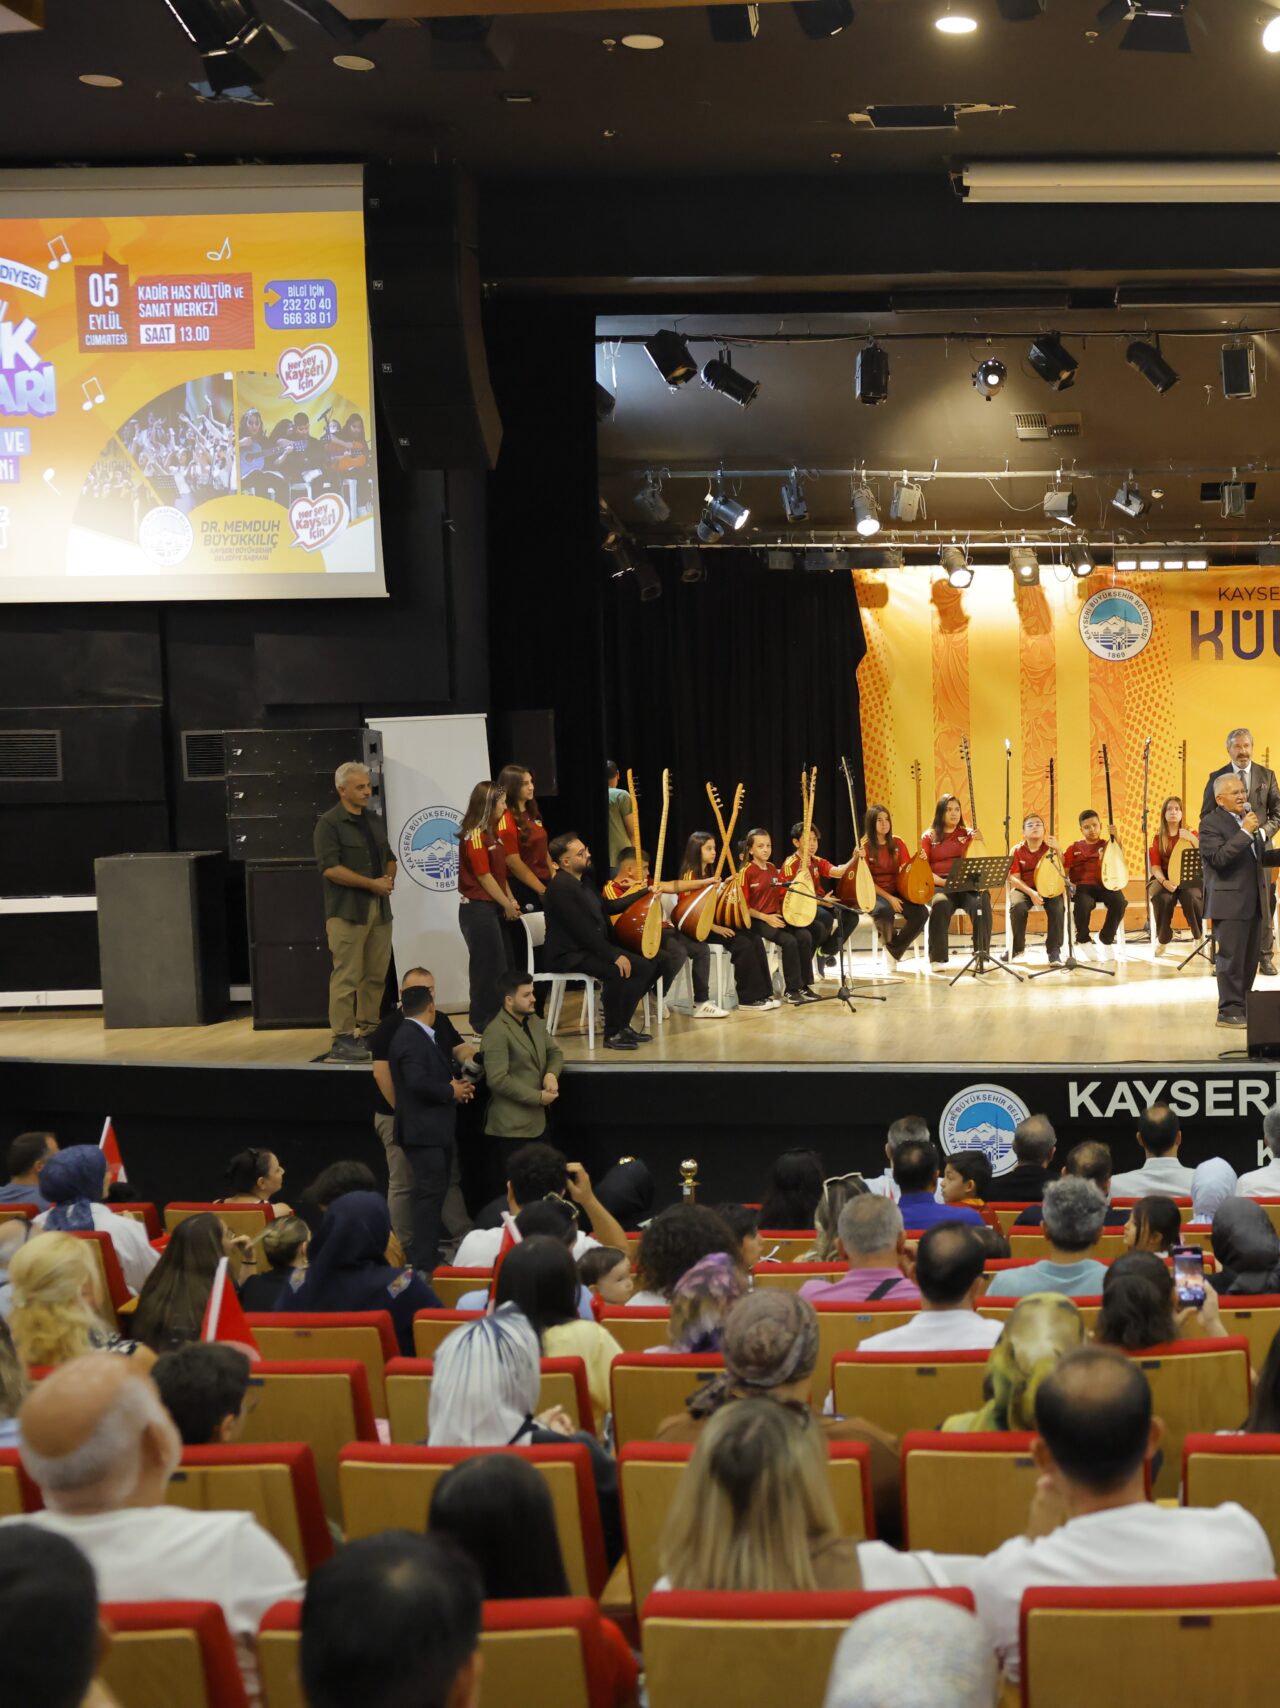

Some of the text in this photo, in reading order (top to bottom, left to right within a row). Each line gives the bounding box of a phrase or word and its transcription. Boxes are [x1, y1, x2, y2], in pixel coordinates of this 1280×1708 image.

[88, 272, 120, 308] 05
[138, 282, 244, 301] KADİR HAS KÜLTÜR VE
[288, 285, 307, 297] BİLGİ
[139, 300, 218, 317] SANAT MERKEZİ
[283, 298, 332, 311] 232 20 40
[88, 311, 123, 330] EYLÜL
[283, 312, 331, 325] 666 38 01
[145, 326, 210, 343] SAAT 13.00
[285, 360, 325, 381] Kayseri
[4, 431, 24, 452] VE
[200, 520, 280, 533] DR. MEMDUH
[204, 533, 279, 547] BÜYÜKKILIÇ
[435, 880, 455, 889] 1869
